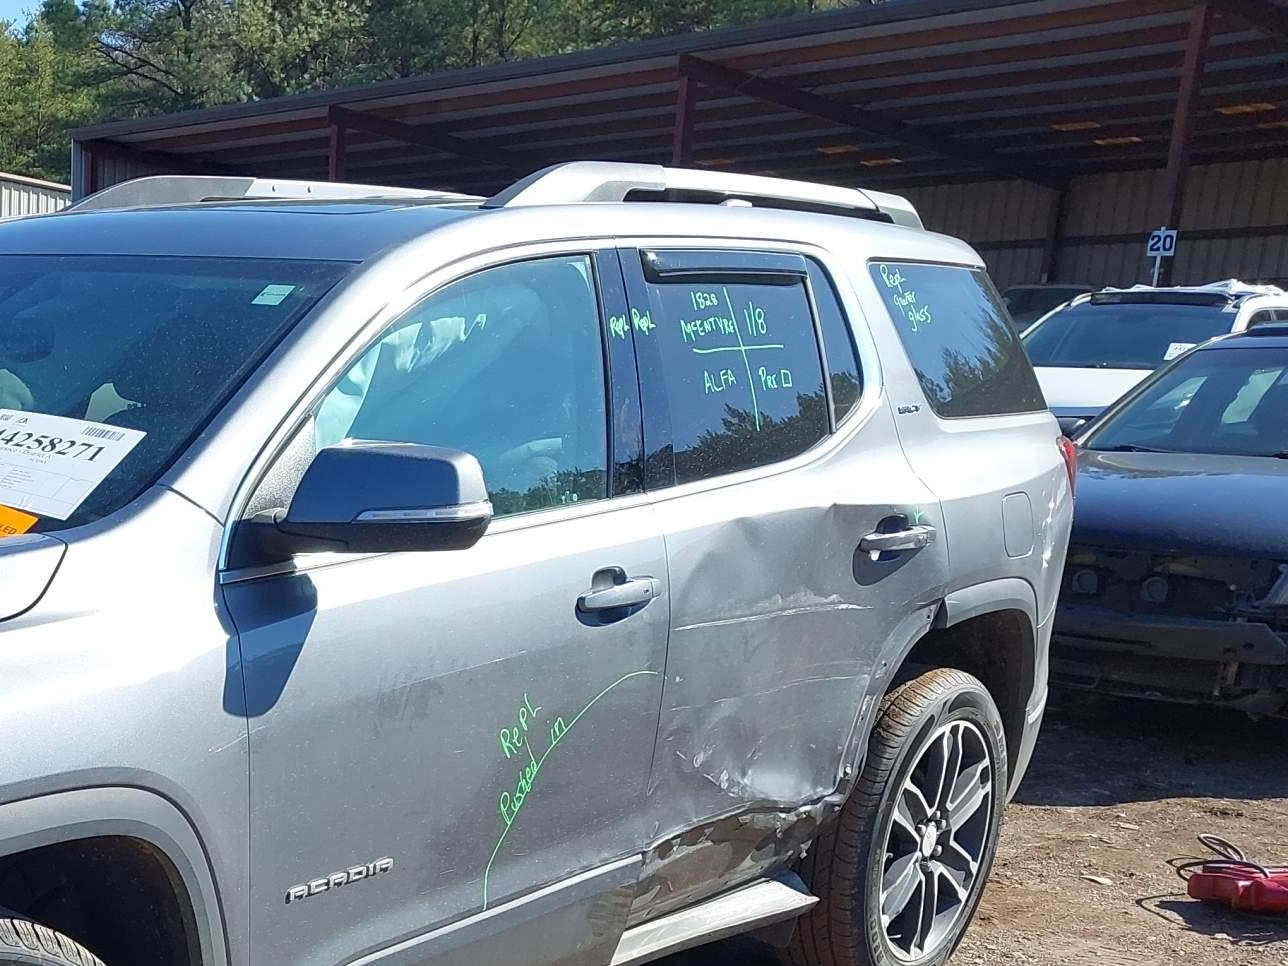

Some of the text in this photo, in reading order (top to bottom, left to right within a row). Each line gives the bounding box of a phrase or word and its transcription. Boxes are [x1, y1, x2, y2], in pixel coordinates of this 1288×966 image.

[1149, 233, 1175, 252] 20
[690, 291, 718, 311] 1828
[703, 369, 737, 394] ALFA
[284, 857, 394, 905] ACADIA
